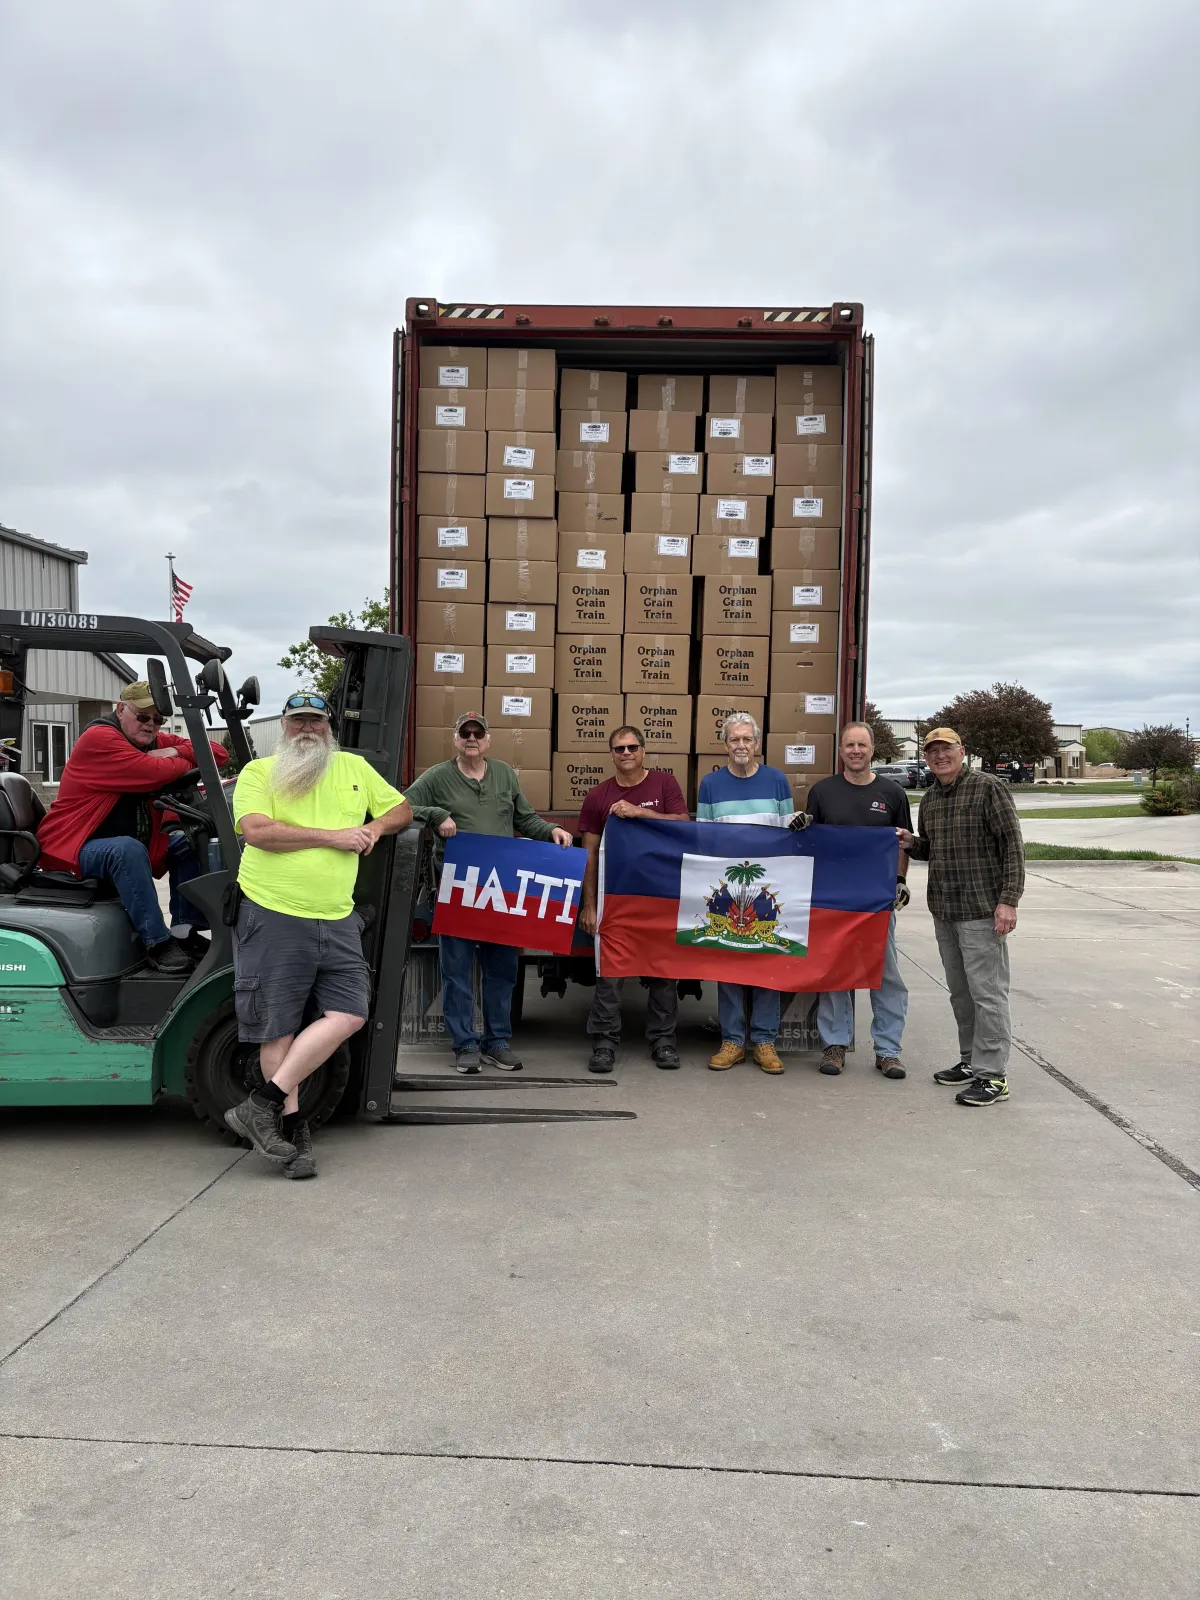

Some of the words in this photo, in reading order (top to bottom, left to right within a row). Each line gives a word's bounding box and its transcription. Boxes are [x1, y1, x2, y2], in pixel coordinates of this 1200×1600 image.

[572, 586, 610, 597] Orphan
[639, 586, 677, 597] Orphan
[718, 585, 757, 596] Orphan
[576, 598, 605, 607] Grain
[643, 598, 673, 607] Grain
[722, 597, 752, 607] Grain
[576, 609, 605, 619] Train
[643, 609, 672, 619] Train
[723, 609, 751, 619] Train
[569, 645, 607, 655] Orphan
[637, 646, 675, 657] Orphan
[716, 648, 754, 659] Orphan
[573, 657, 603, 666] Grain
[641, 658, 670, 668] Grain
[720, 660, 750, 670] Grain
[573, 668, 602, 678] Train
[641, 670, 670, 680] Train
[720, 672, 749, 681] Train
[571, 705, 609, 716] Orphan
[639, 706, 678, 717] Orphan
[575, 717, 605, 727] Grain
[643, 718, 673, 727] Grain
[576, 729, 605, 738] Train
[643, 729, 672, 739] Train
[566, 764, 604, 775] Orphan
[570, 776, 600, 786] Grain
[570, 787, 588, 797] Tra
[438, 863, 582, 924] HAITI
